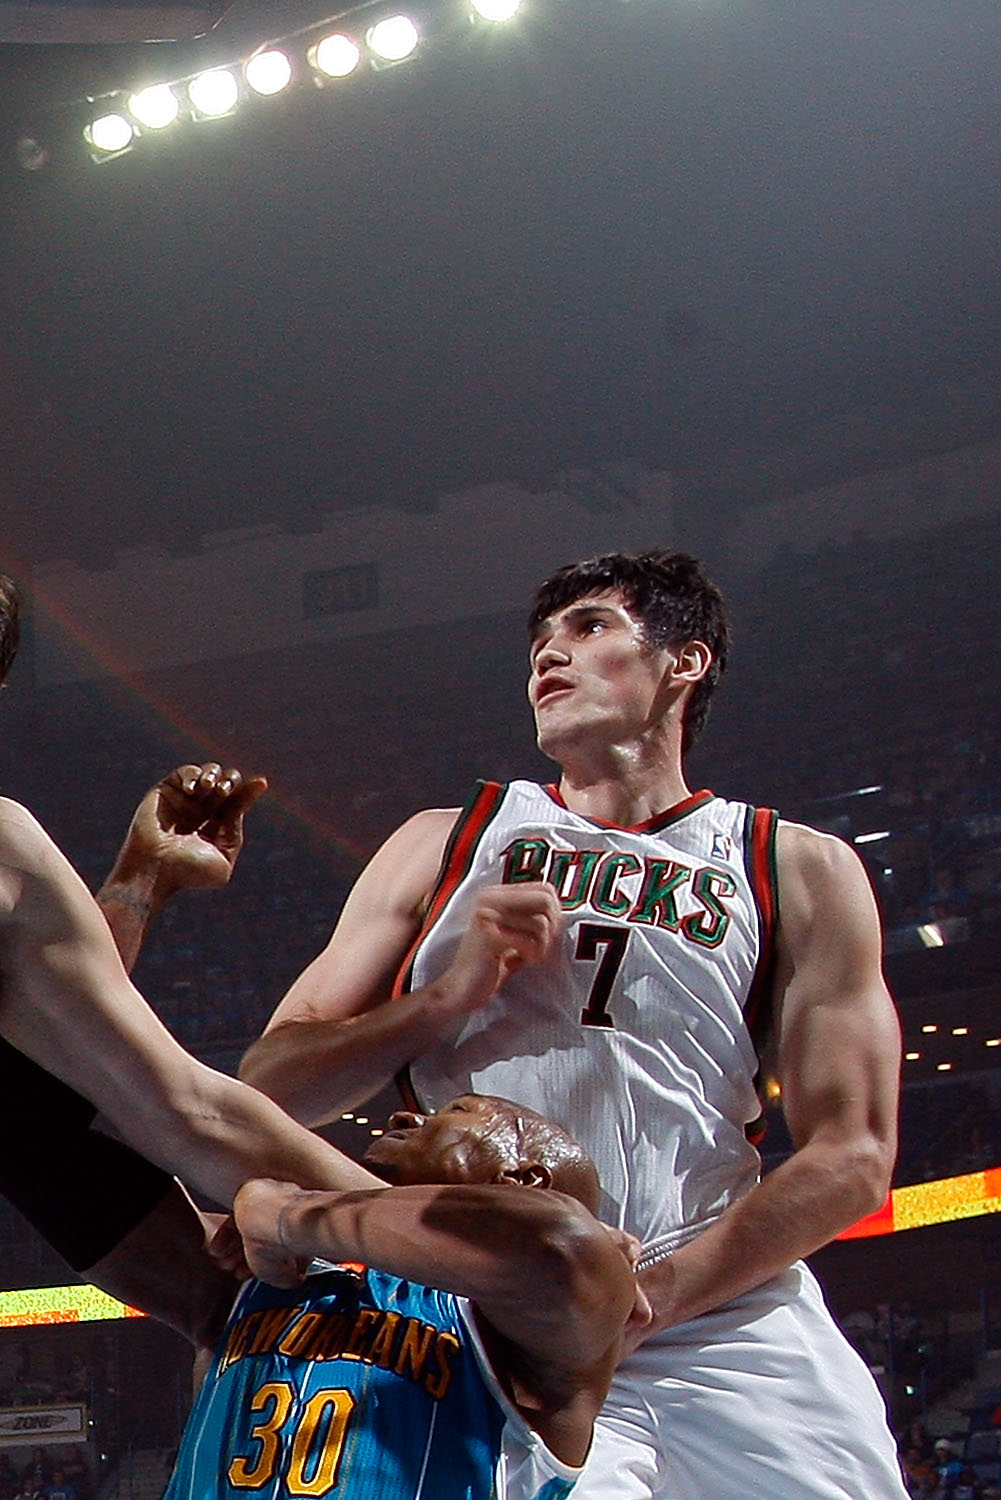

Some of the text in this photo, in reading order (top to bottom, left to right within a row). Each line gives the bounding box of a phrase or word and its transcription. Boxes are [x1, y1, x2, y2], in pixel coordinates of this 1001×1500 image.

[501, 837, 736, 949] BUCKS
[574, 922, 631, 1028] 7
[226, 1380, 356, 1499] 30
